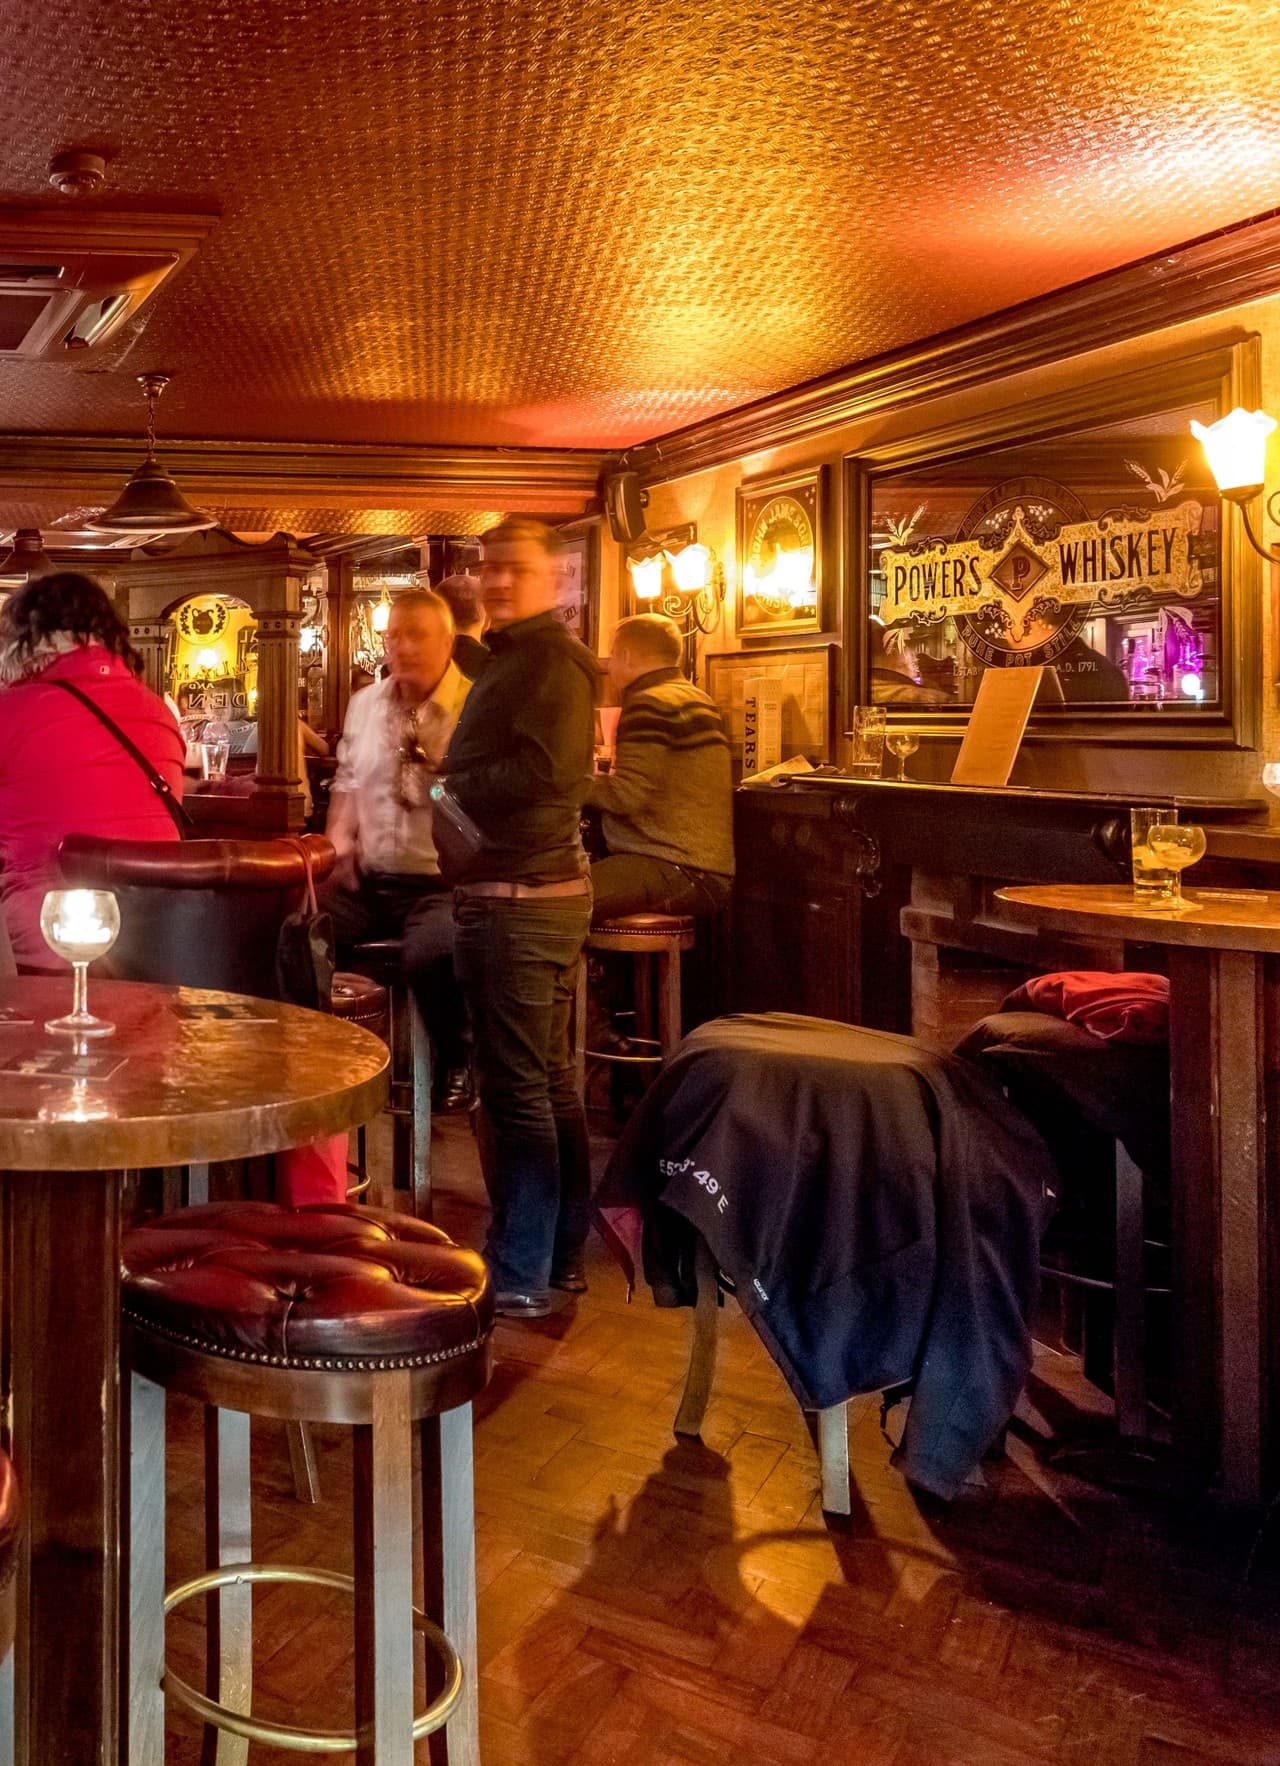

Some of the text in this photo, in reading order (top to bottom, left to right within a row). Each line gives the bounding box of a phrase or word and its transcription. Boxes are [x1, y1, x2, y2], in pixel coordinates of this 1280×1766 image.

[894, 553, 982, 605] POWER'S
[1059, 527, 1177, 586] WHISKEY
[961, 620, 1082, 667] PURE POT STILL
[745, 696, 756, 769] TEARS
